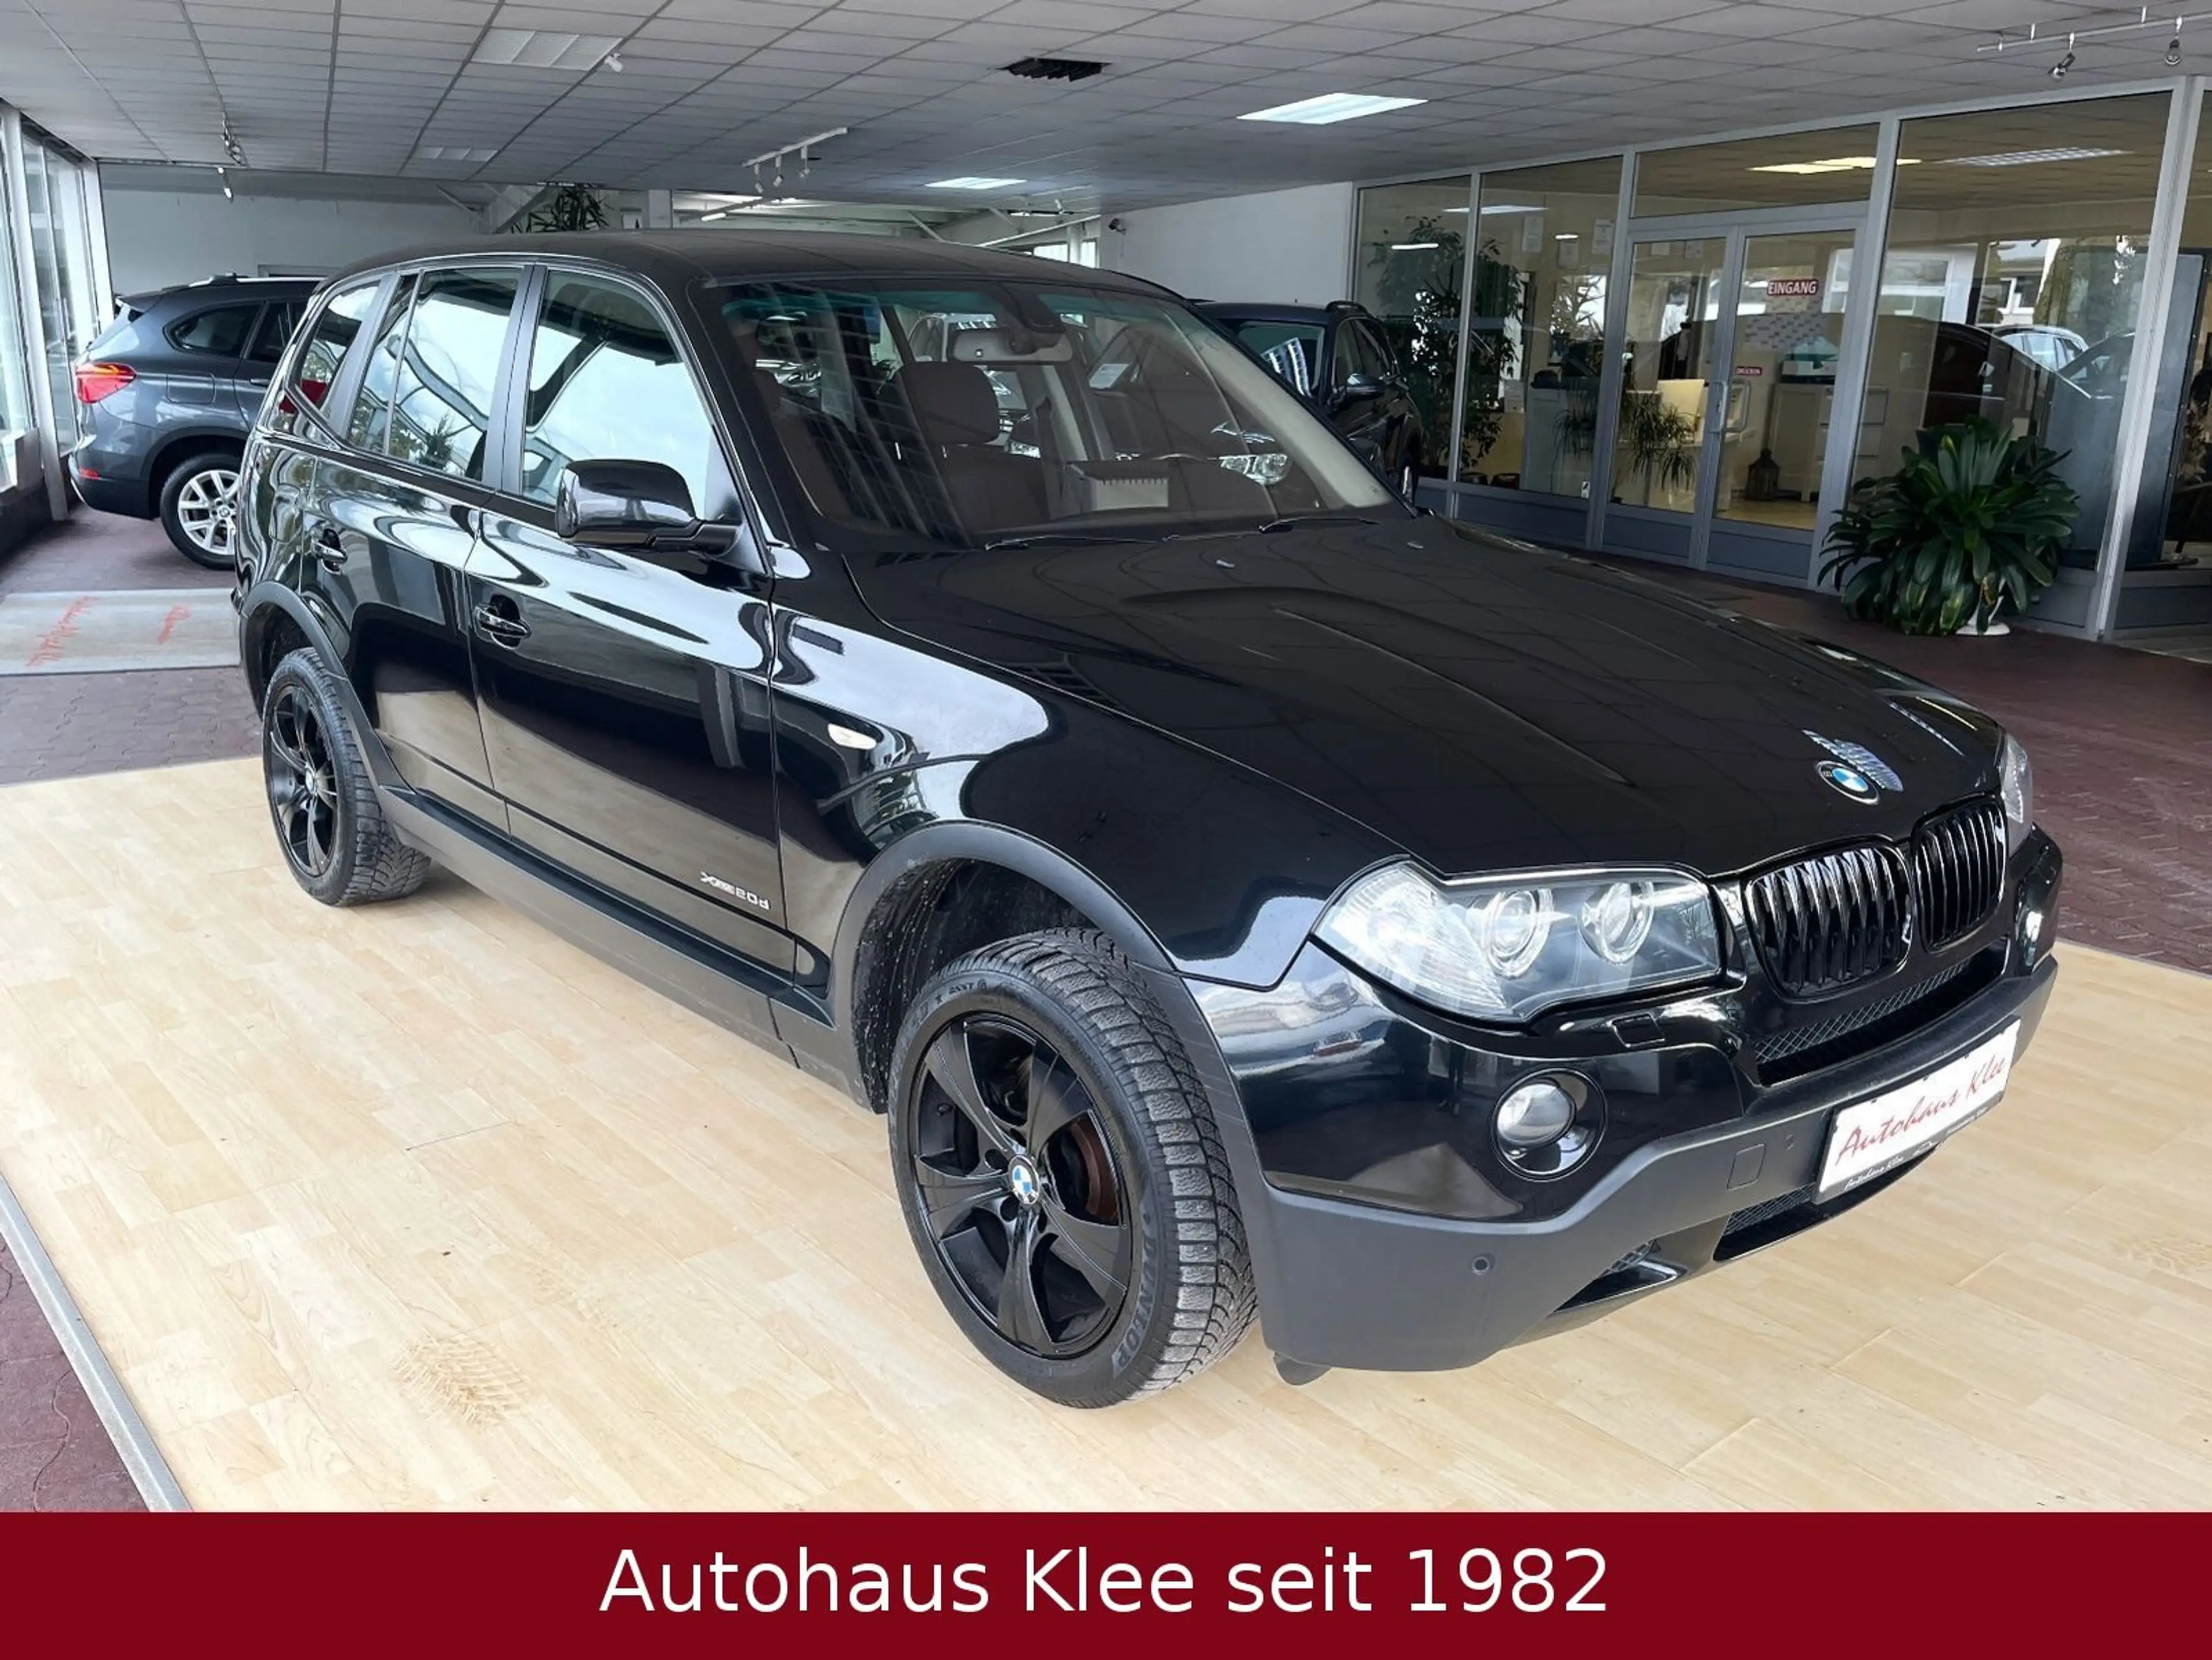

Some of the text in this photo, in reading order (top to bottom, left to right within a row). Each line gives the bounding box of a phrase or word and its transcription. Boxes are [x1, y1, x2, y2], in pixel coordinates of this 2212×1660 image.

[1768, 281, 1817, 295] EINGANG
[1835, 1088, 1959, 1165] Autohaus
[1966, 1054, 2005, 1098] Klee
[1117, 1234, 1158, 1369] DUNLOP
